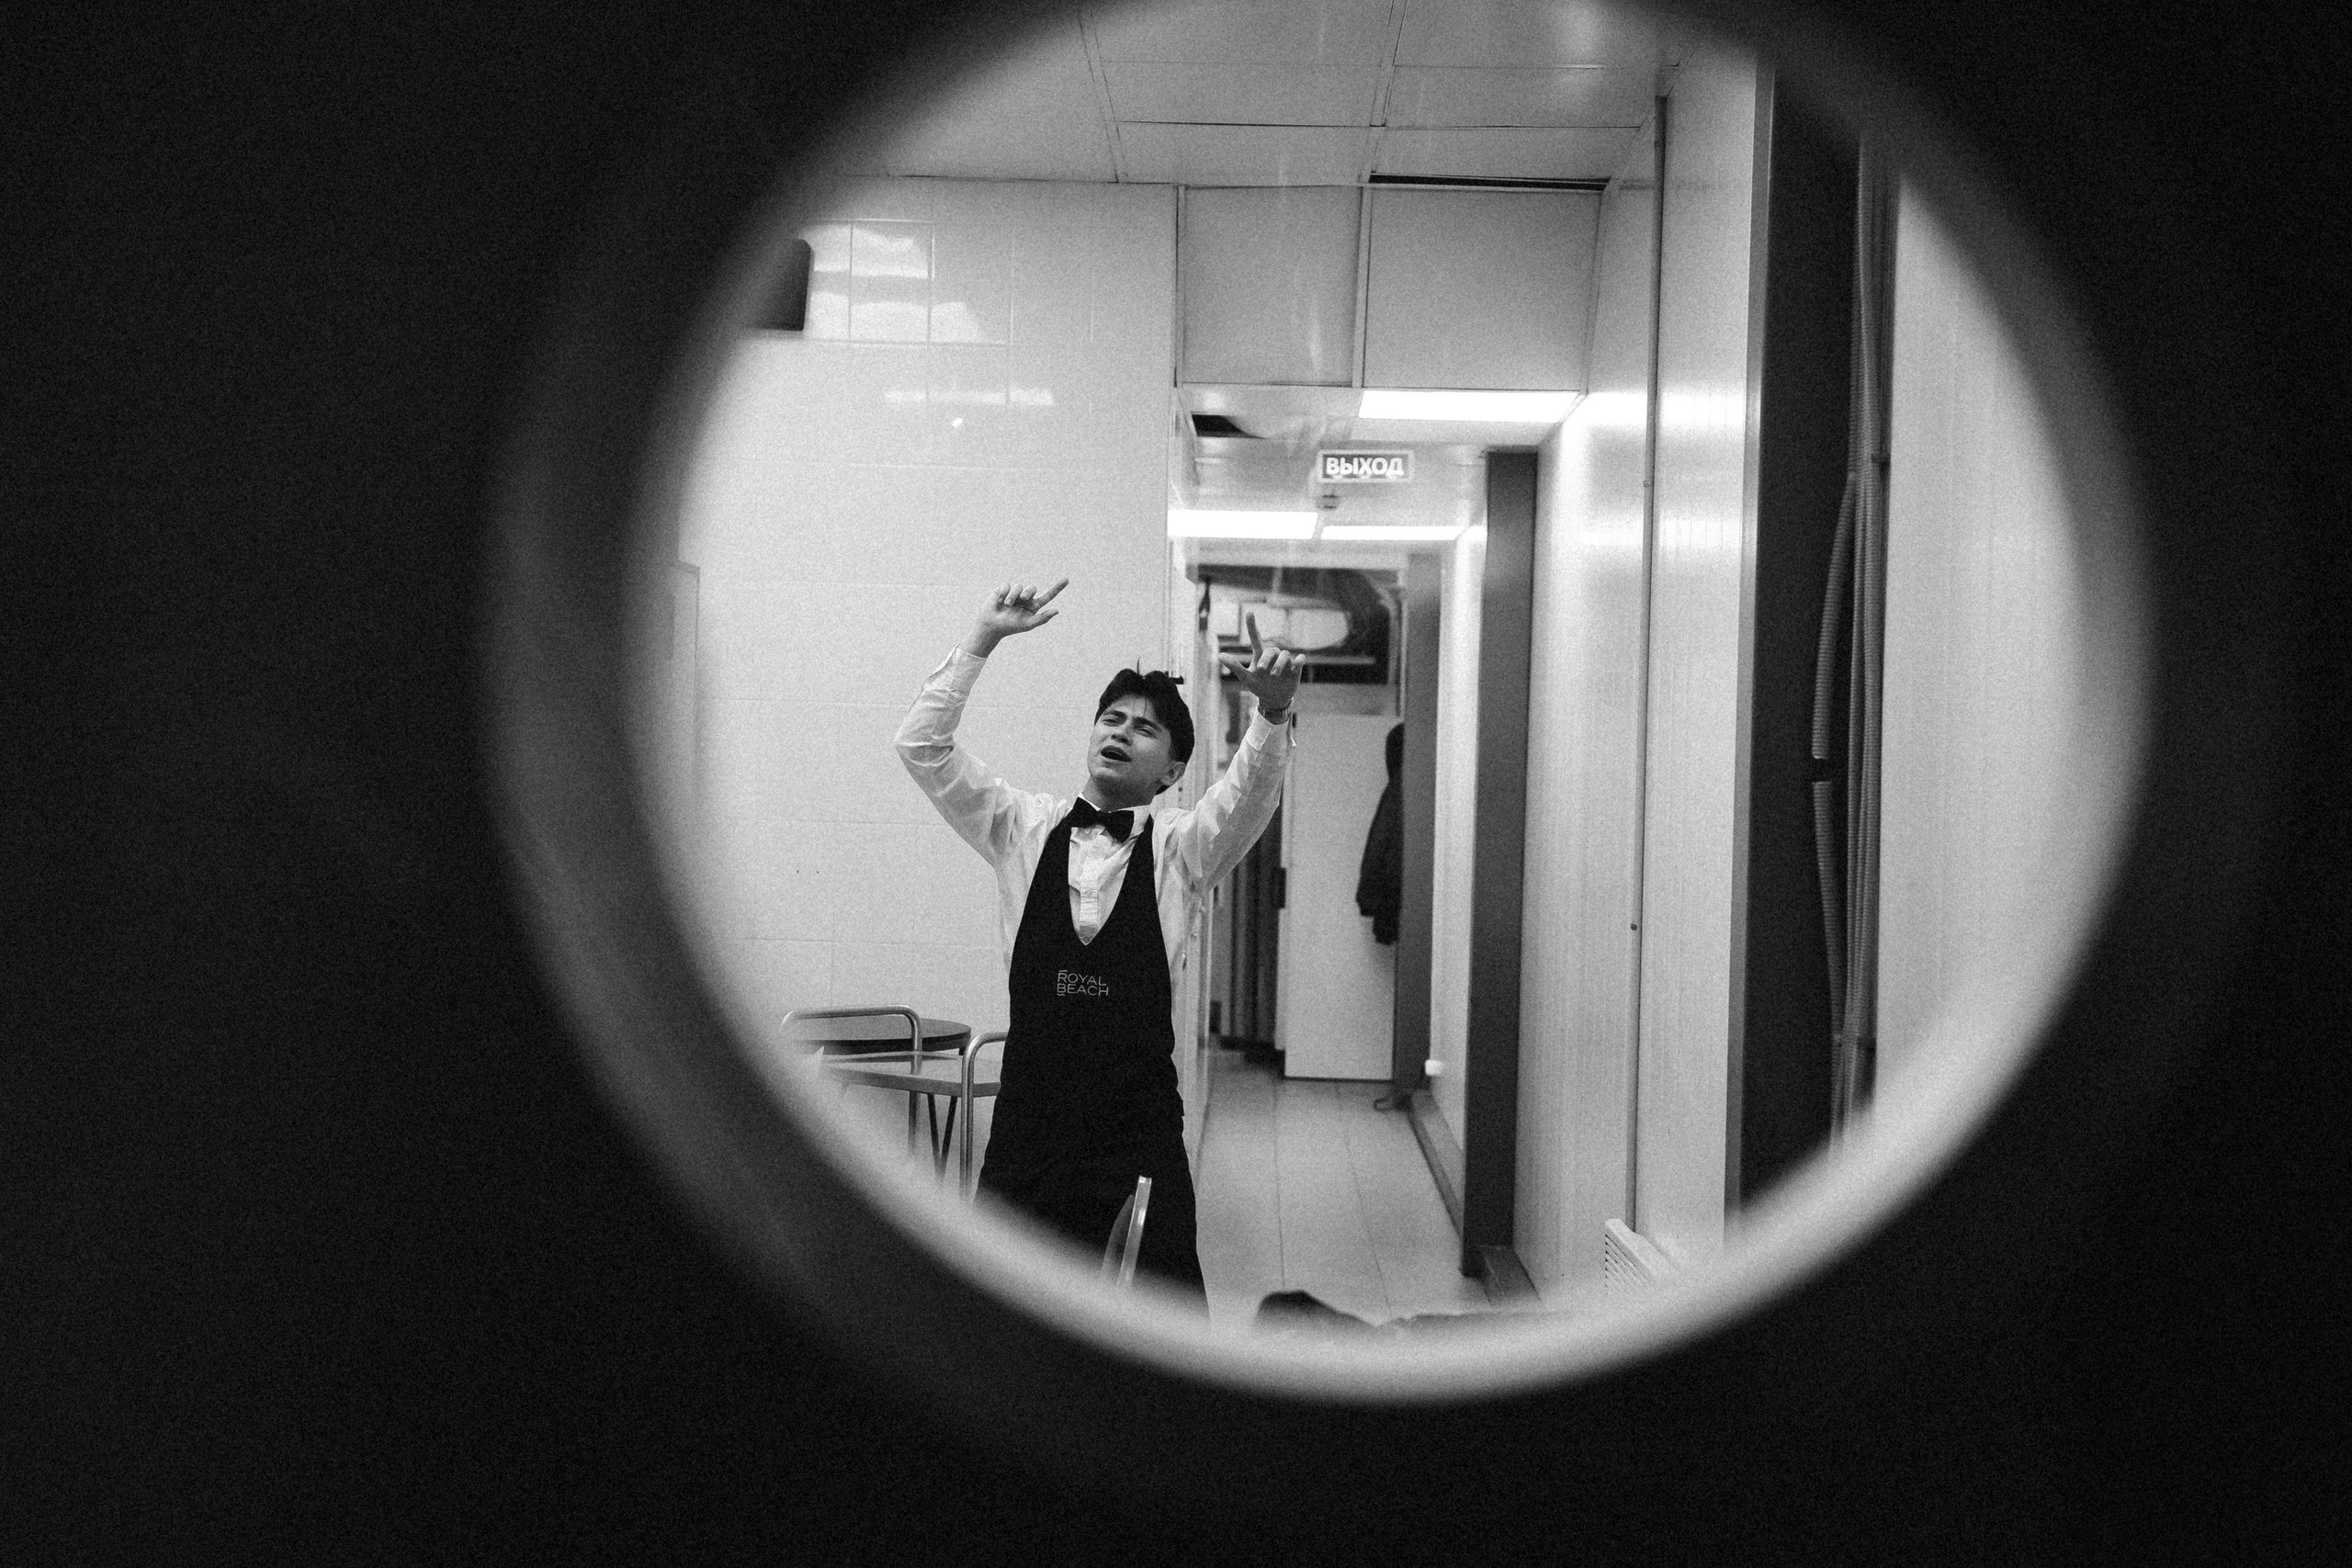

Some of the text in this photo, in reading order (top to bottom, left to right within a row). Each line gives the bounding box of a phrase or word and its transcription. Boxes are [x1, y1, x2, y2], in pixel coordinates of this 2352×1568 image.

[1326, 457, 1405, 477] ВЫХОД
[1057, 971, 1108, 987] ROYAL
[1057, 983, 1109, 997] BEACH
